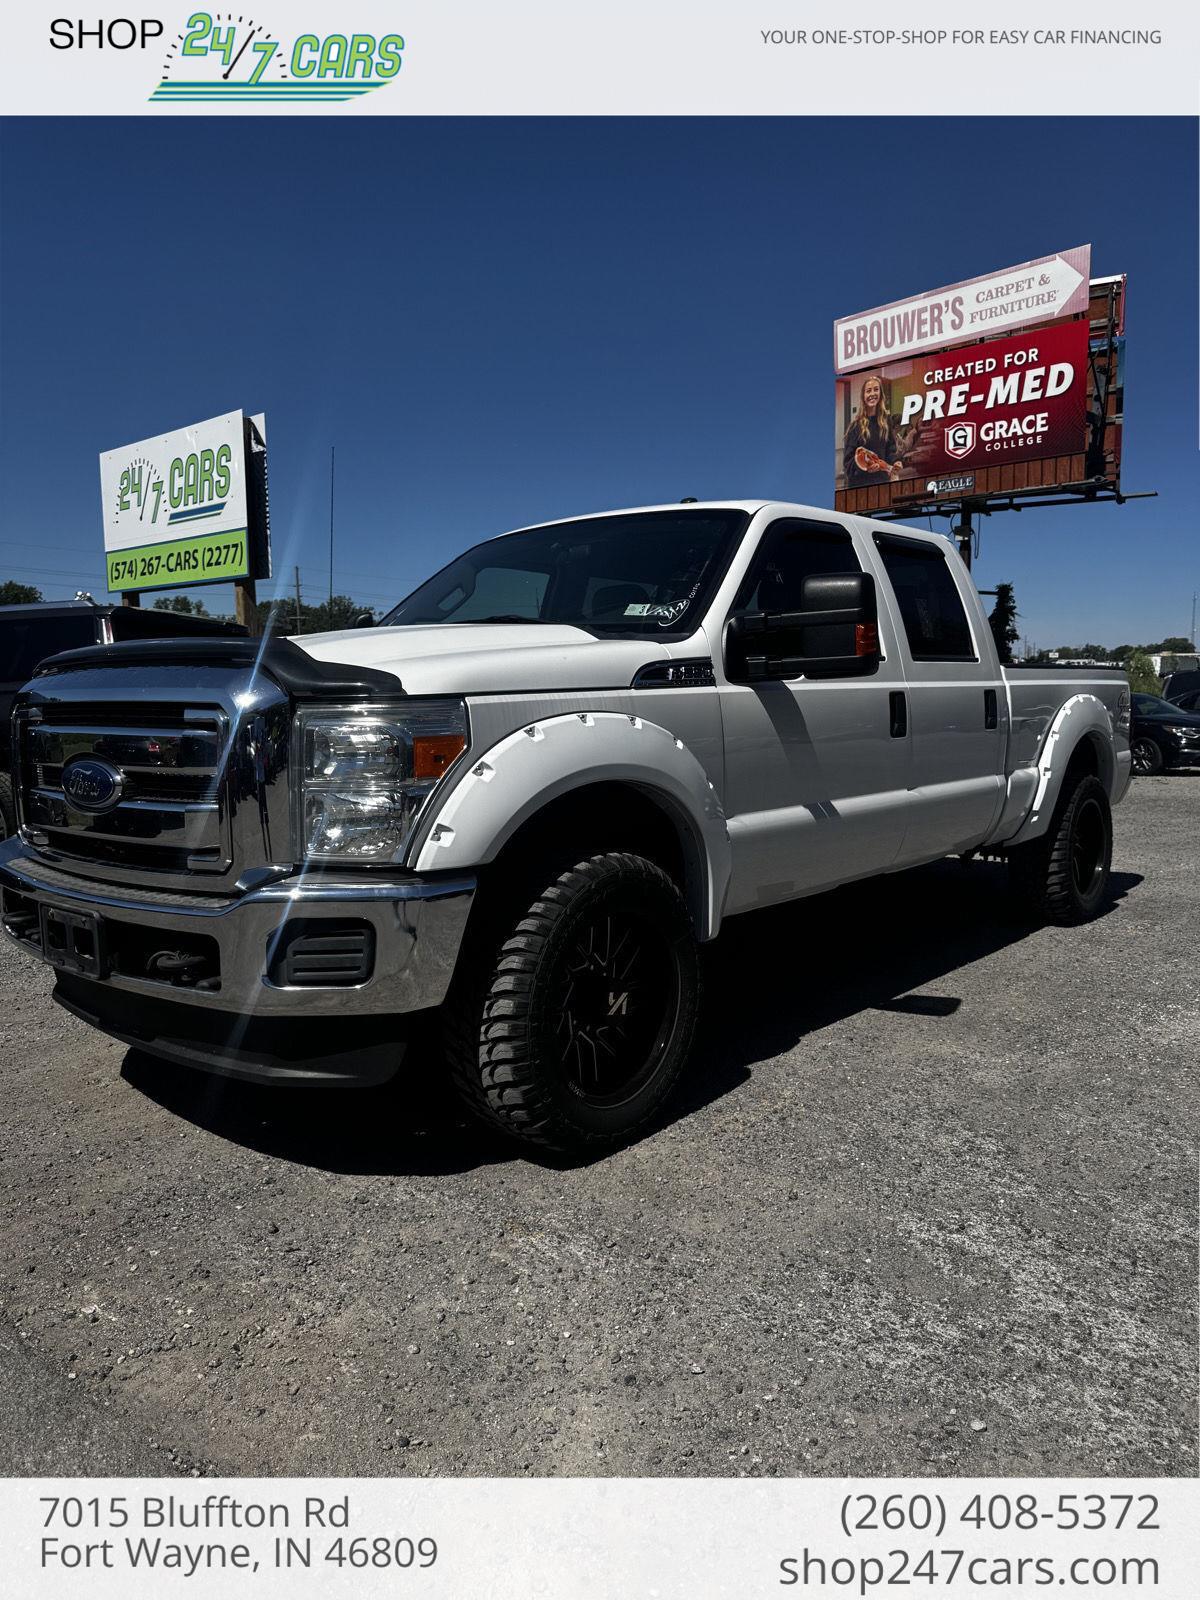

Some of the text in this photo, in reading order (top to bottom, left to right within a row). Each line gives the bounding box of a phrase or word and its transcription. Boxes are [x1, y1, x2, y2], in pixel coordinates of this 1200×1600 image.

[969, 289, 1057, 324] FURNITURE
[975, 273, 1051, 305] CARPET &
[843, 295, 964, 360] BROUWER'S
[923, 347, 1039, 386] CREATED FOR
[900, 362, 1074, 426] PRE-MED
[980, 412, 1049, 442] GRACE
[985, 435, 1043, 452] COLLEGE
[169, 443, 232, 509] CARS
[938, 476, 973, 490] EAGLE
[110, 541, 243, 583] (574) 267-CARS (2277)
